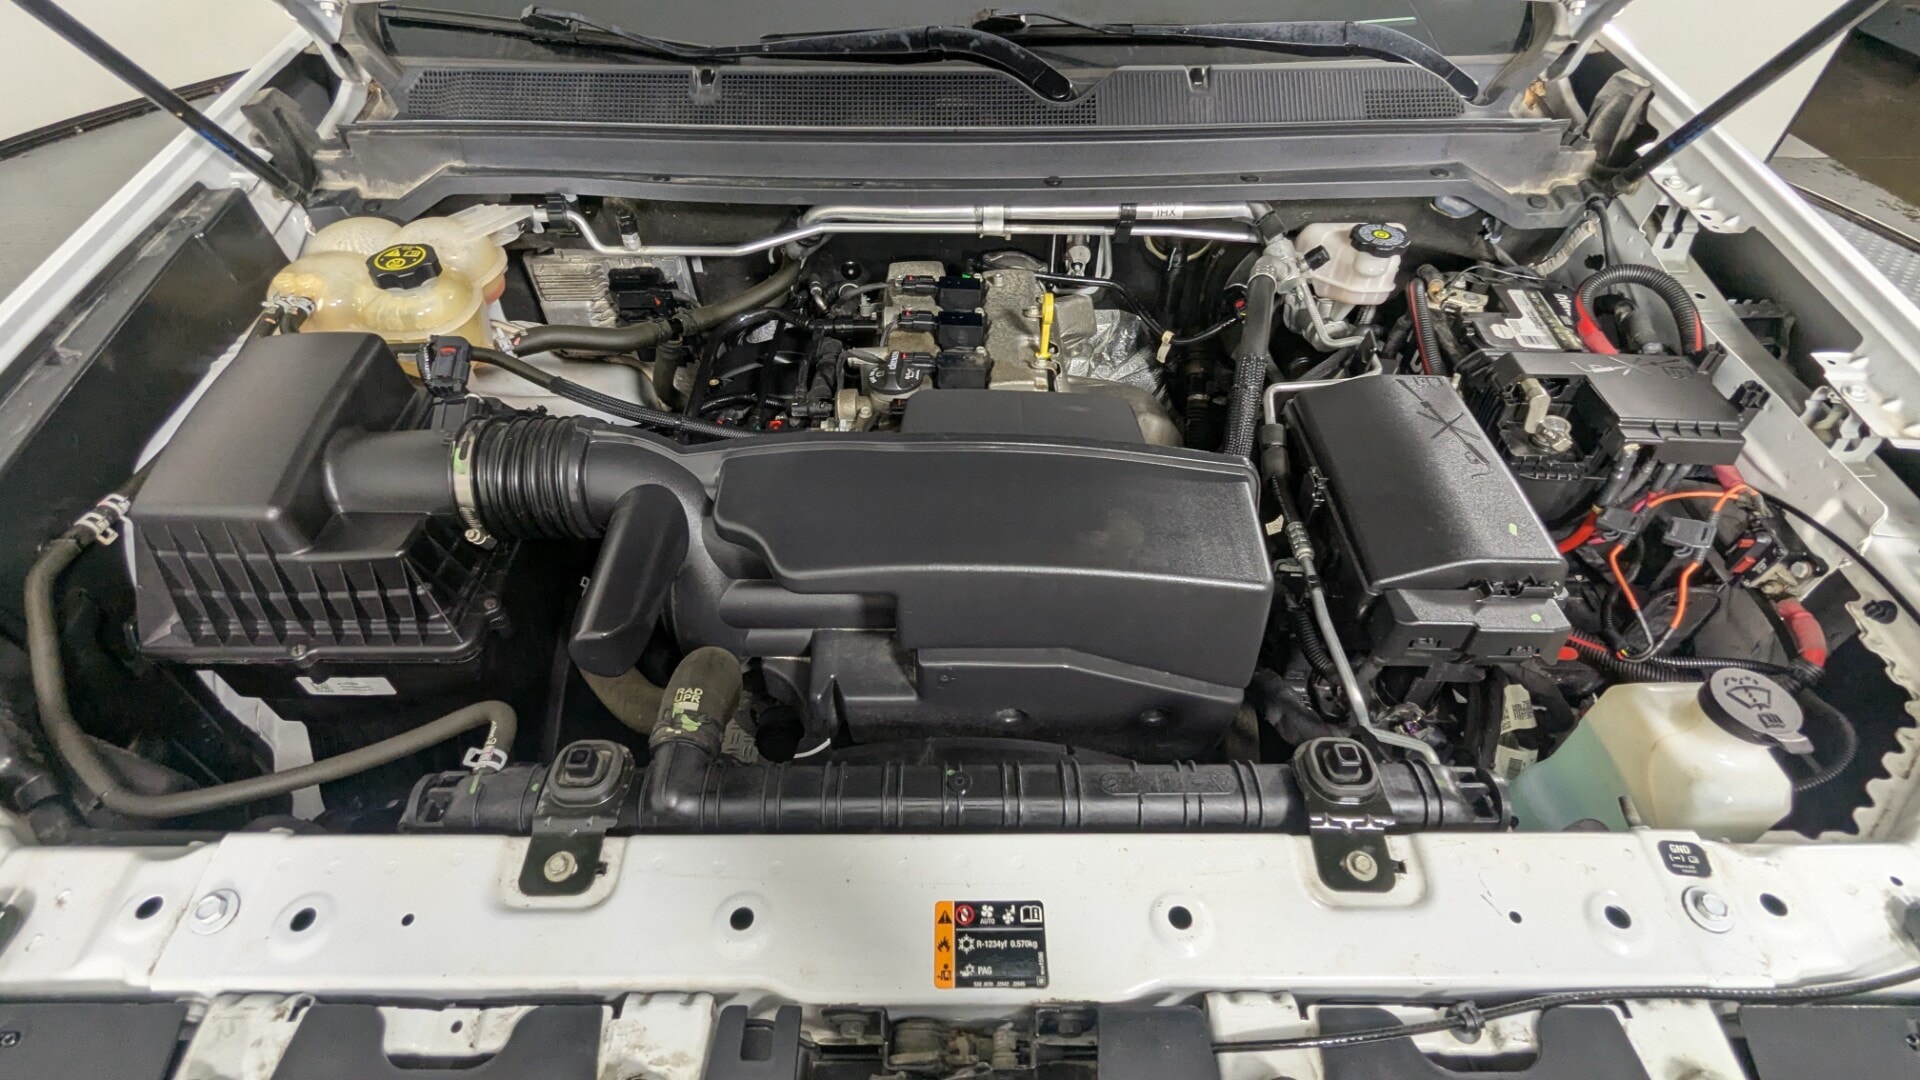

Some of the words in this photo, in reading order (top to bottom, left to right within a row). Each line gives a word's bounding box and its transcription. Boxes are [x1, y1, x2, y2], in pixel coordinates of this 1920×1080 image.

[676, 688, 703, 696] RAD
[674, 693, 701, 703] UPR
[1669, 844, 1690, 854] GND
[976, 940, 1008, 950] R-1234yf
[977, 966, 993, 975] PAG
